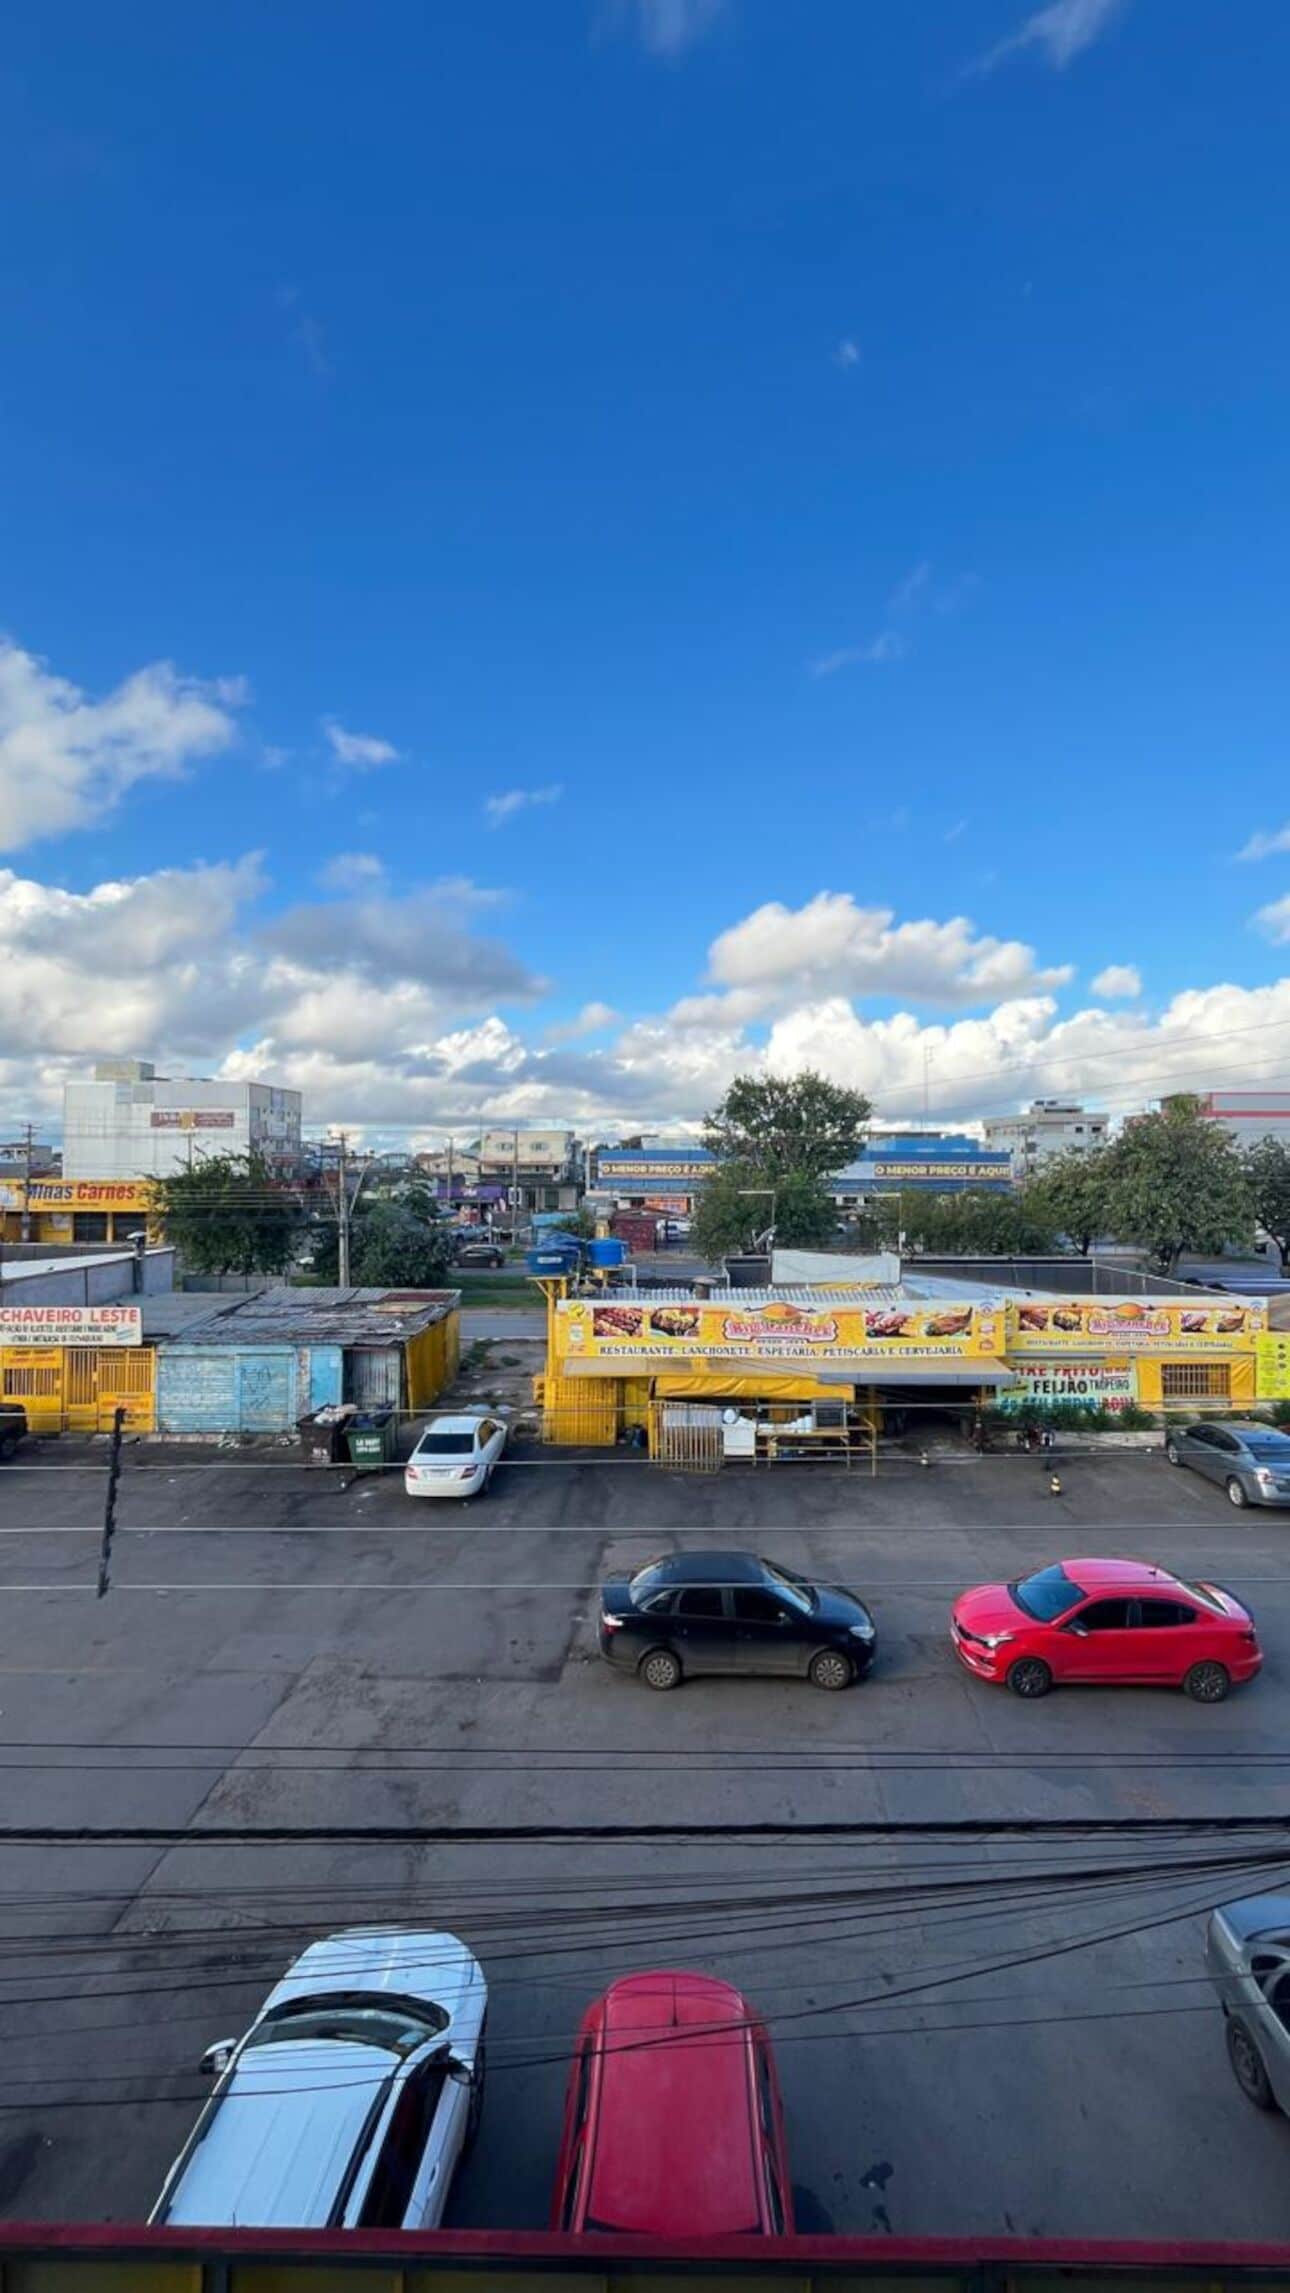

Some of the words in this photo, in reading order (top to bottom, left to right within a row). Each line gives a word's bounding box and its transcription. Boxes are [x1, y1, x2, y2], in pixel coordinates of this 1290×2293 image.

[886, 1165, 927, 1176] MENOR
[929, 1165, 966, 1178] PREÇO
[77, 1183, 135, 1200] Carnes
[0, 1309, 83, 1323] CHAVEIRO
[90, 1309, 138, 1323] LESTE
[600, 1346, 674, 1355] RESTAURANTE
[682, 1346, 749, 1355] LANCHONETE
[757, 1347, 817, 1356] ESPETARIA
[823, 1347, 886, 1356] PETISCARIA
[898, 1346, 963, 1355] CERVEJARIA
[1033, 1375, 1088, 1395] FEIJÃO
